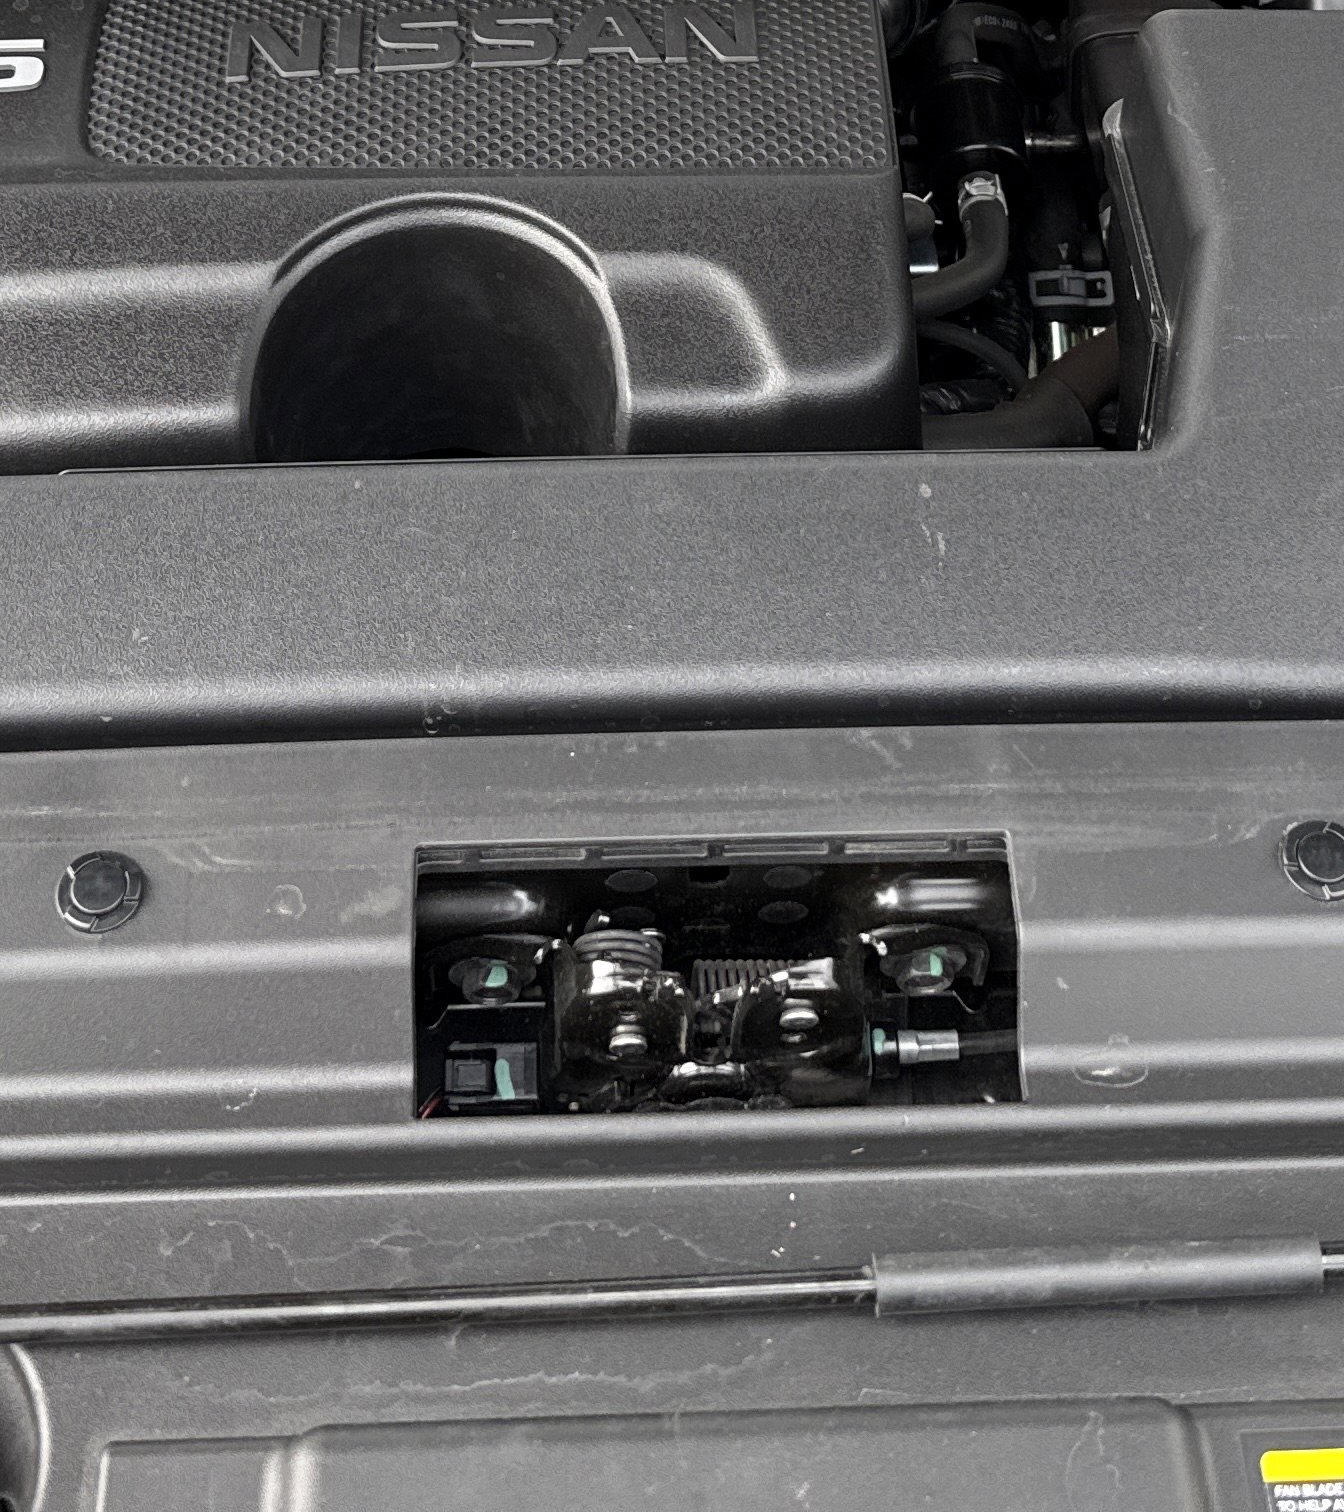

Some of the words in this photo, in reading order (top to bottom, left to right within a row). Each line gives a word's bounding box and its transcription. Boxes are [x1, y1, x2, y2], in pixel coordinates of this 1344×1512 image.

[226, 1, 758, 82] NISSAN
[1302, 1482, 1344, 1497] BLADE
[1298, 1498, 1332, 1512] HELP
